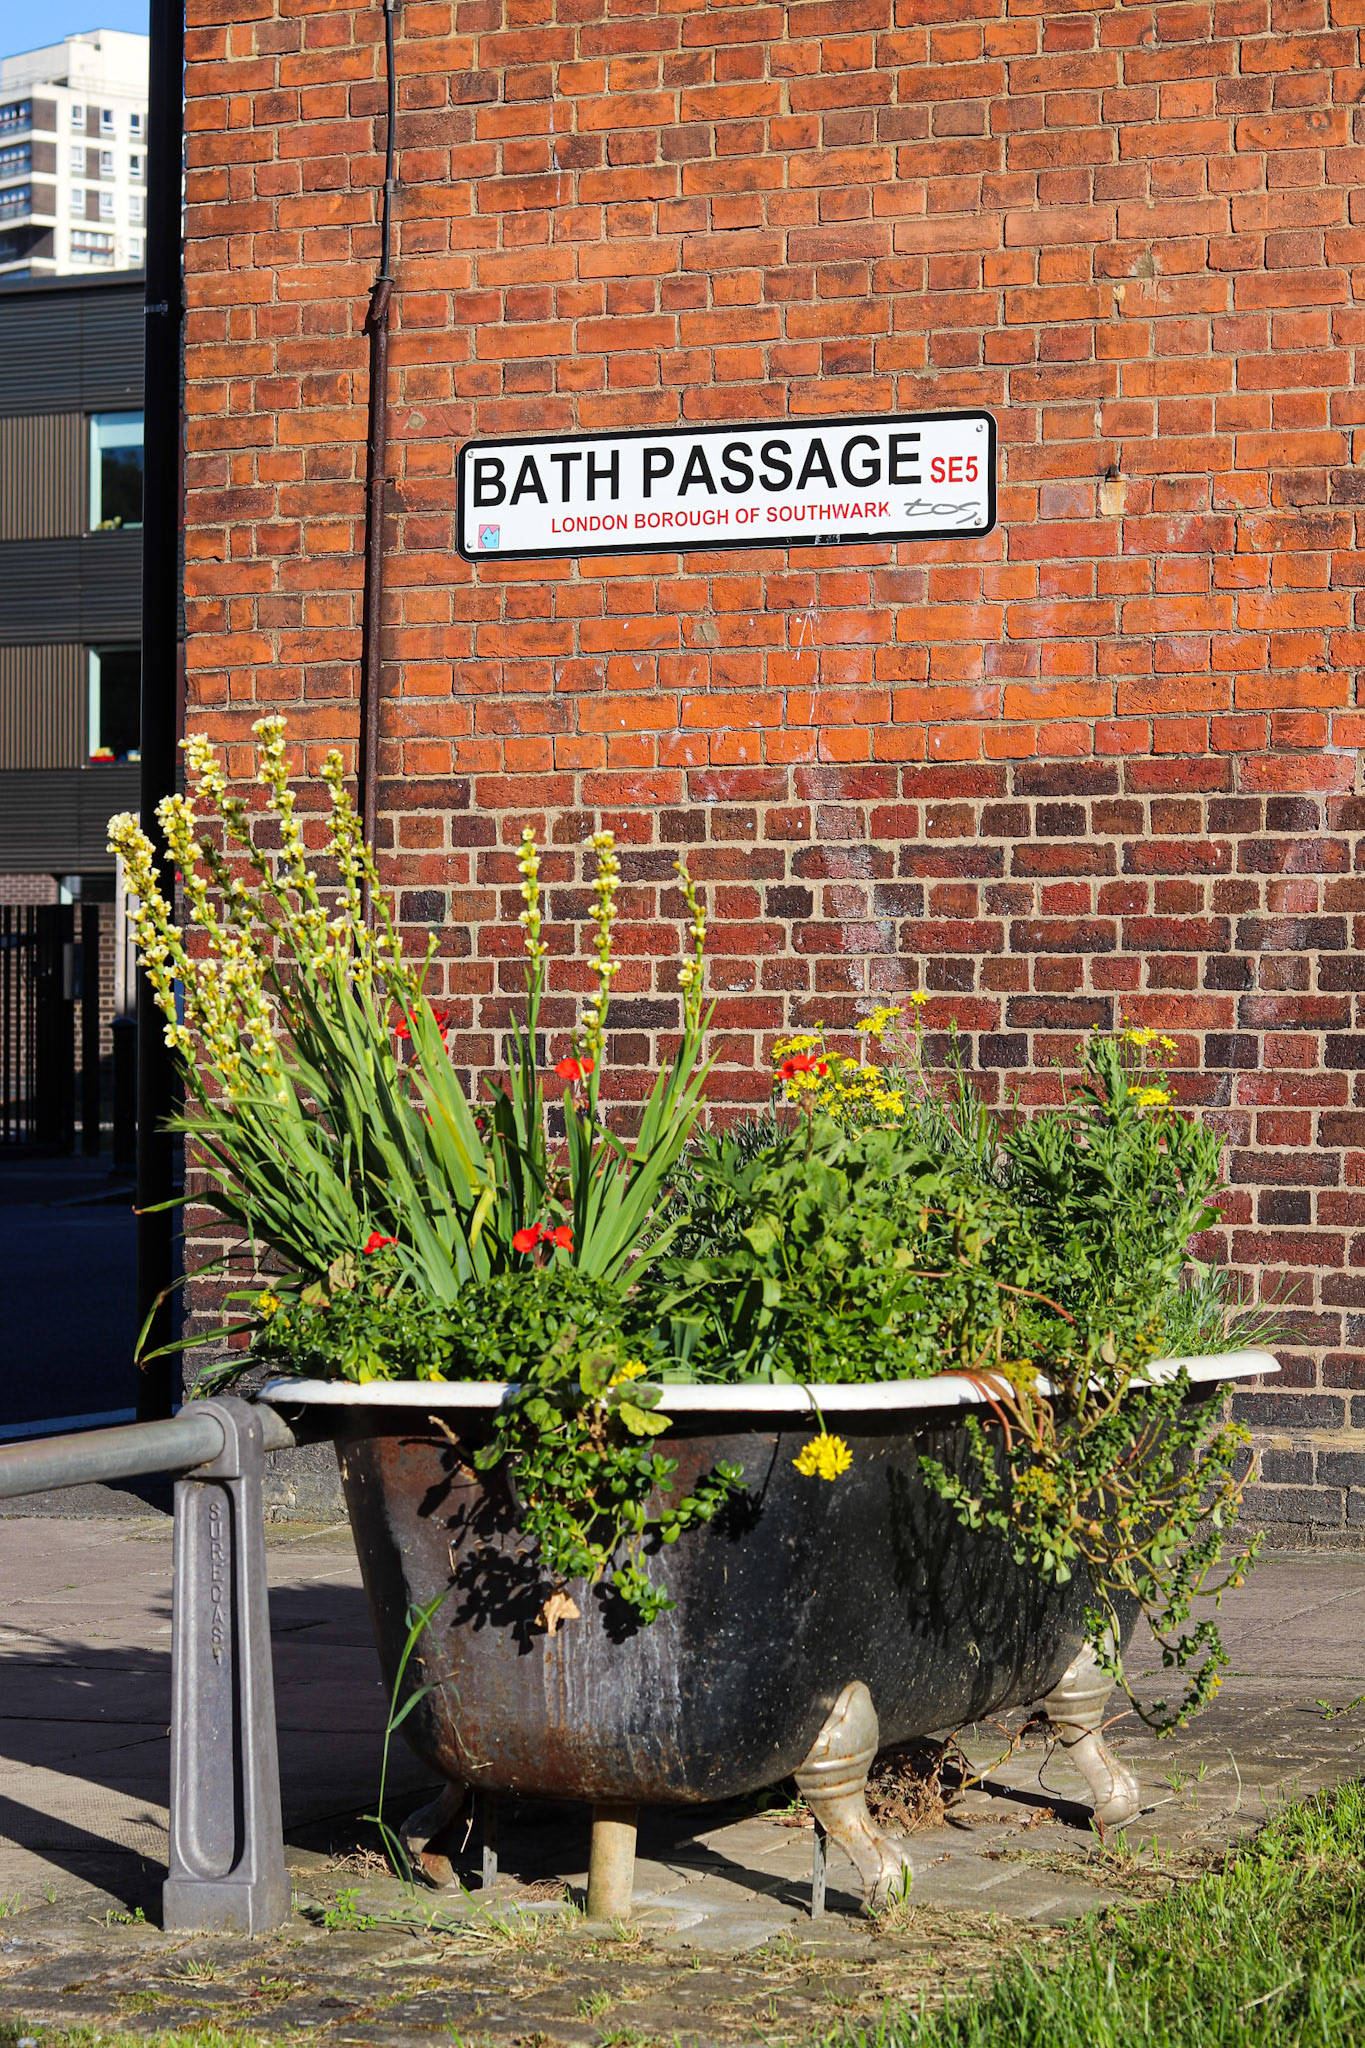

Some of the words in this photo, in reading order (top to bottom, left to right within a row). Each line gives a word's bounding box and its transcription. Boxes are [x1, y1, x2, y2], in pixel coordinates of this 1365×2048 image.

[473, 448, 620, 508] BATH
[643, 432, 922, 498] PASSAGE
[930, 456, 979, 483] SE5
[551, 514, 628, 534] LONDON
[634, 508, 729, 528] BOROUGH
[735, 507, 761, 523] OF
[766, 501, 890, 522] SOUTHWARK
